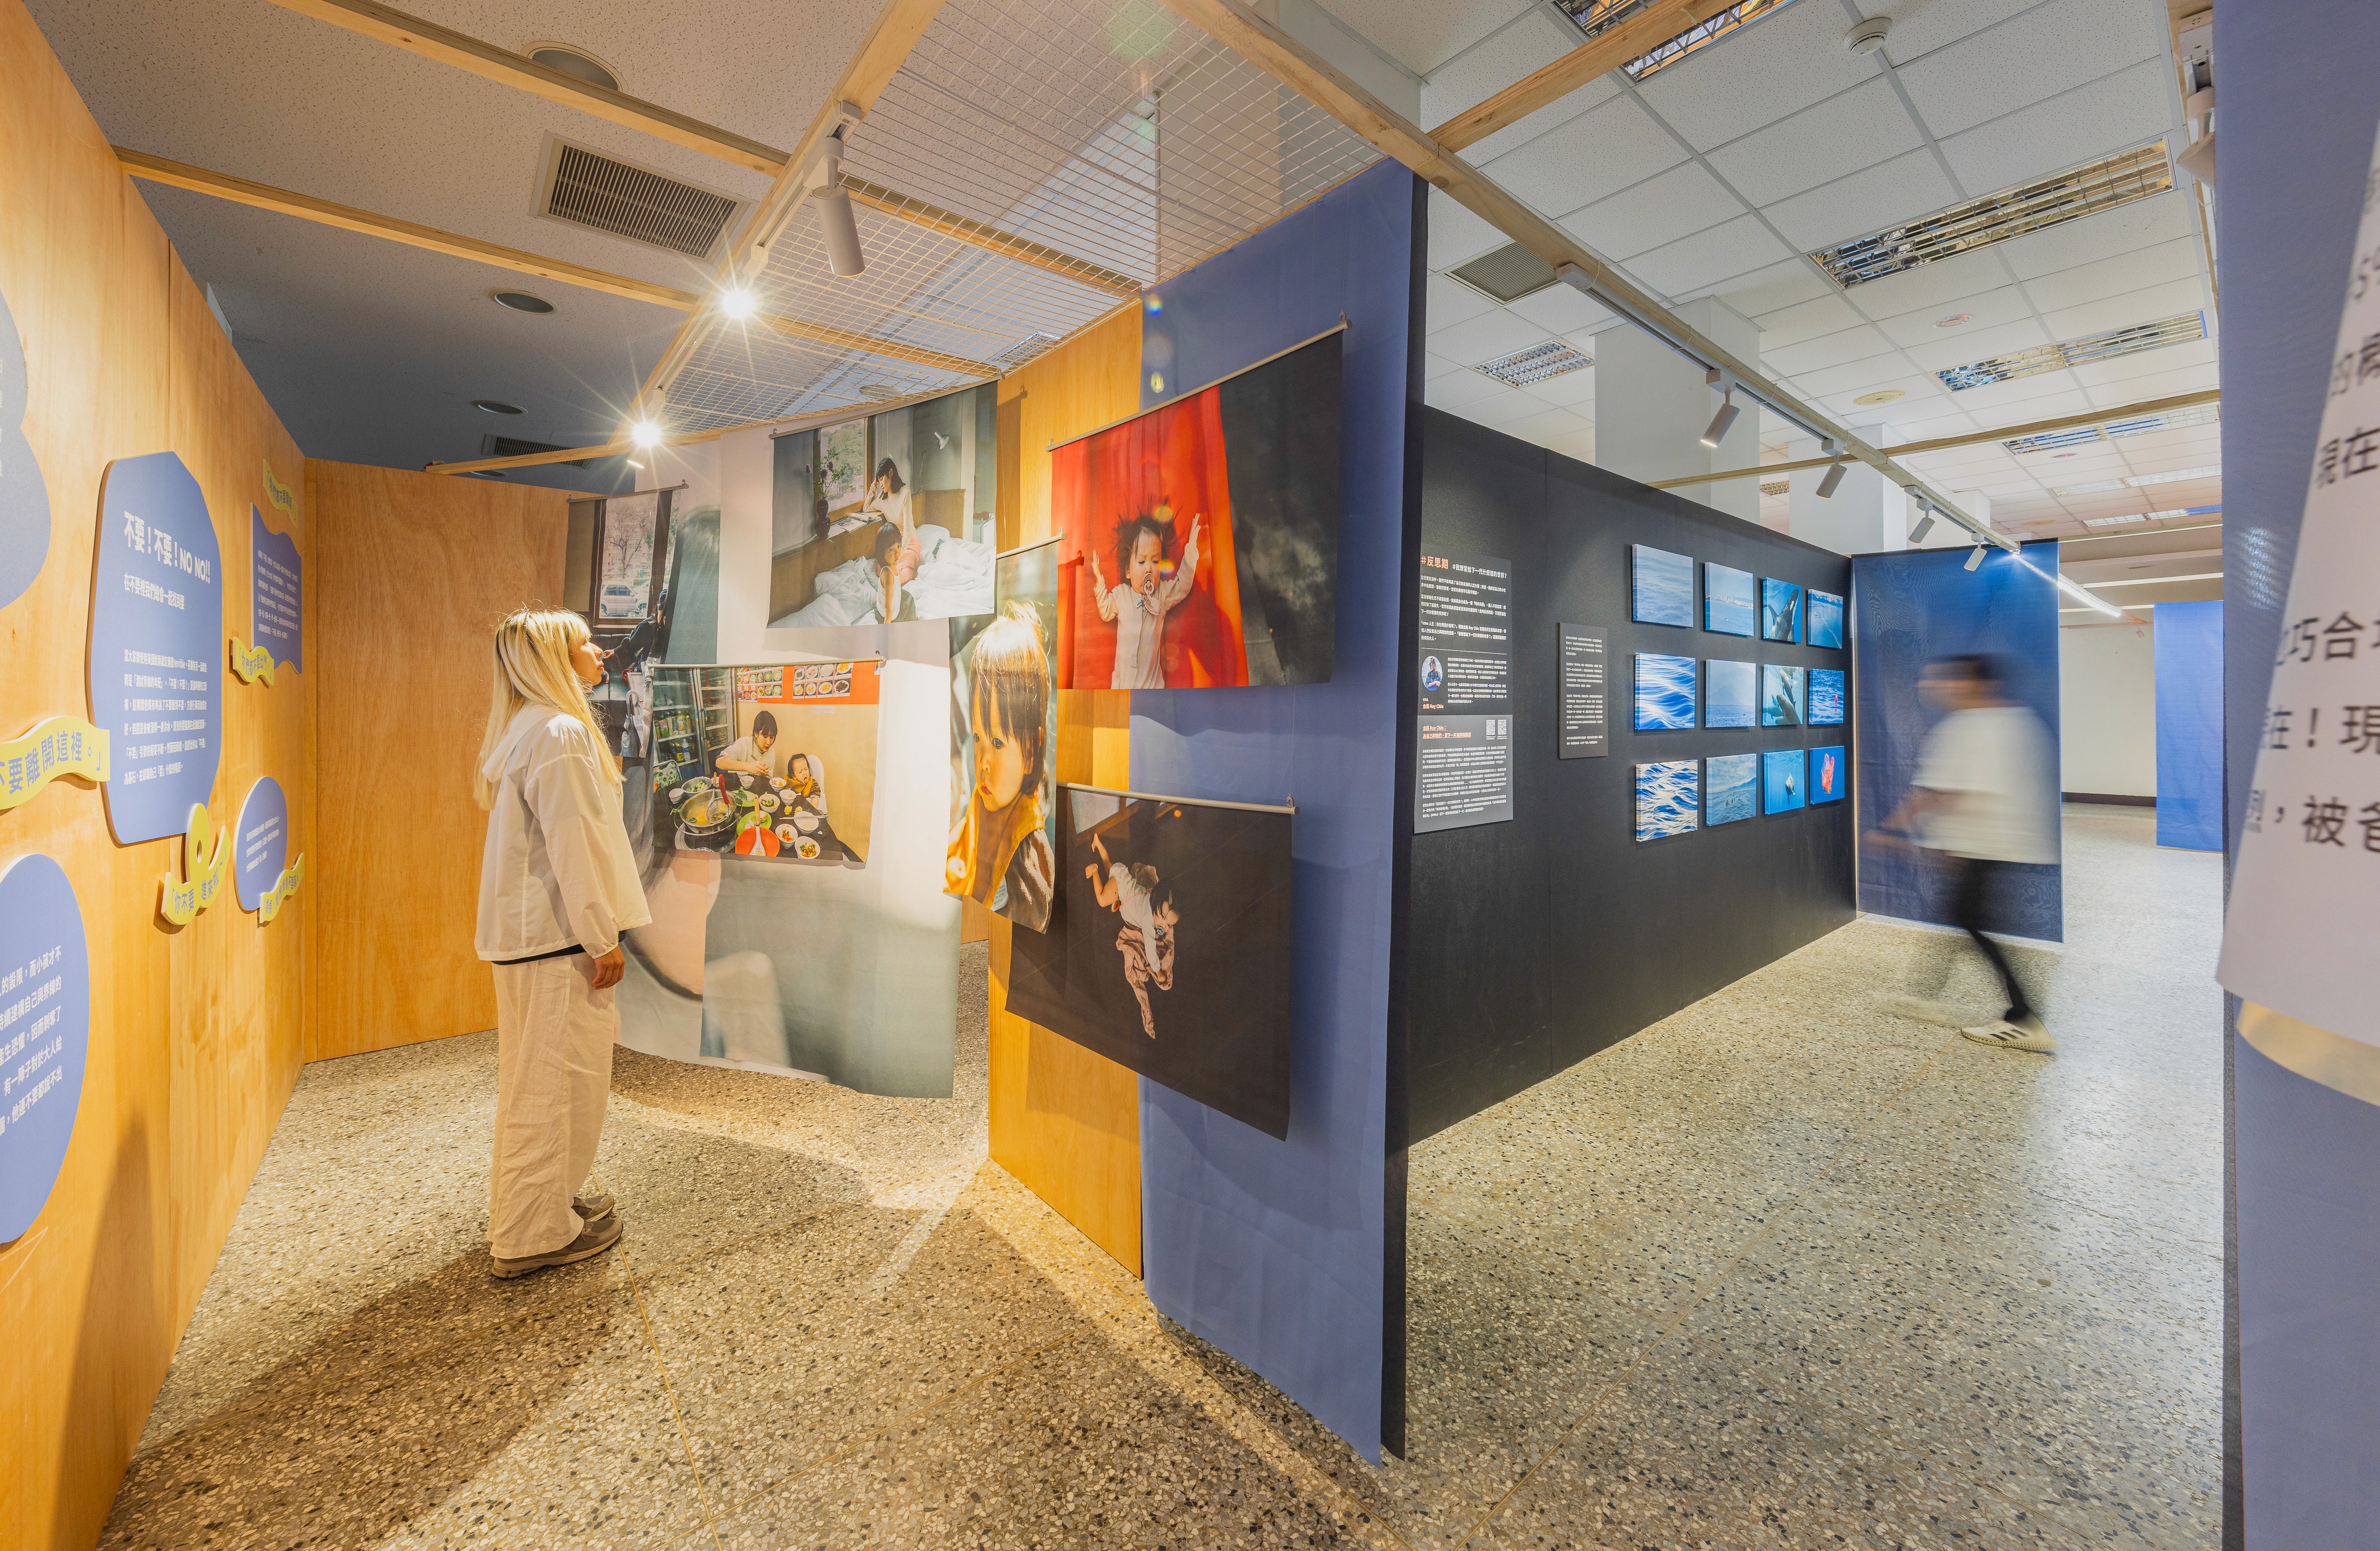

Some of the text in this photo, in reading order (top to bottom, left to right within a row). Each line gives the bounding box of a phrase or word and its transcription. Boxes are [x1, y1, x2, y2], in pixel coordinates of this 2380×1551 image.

[1421, 555, 1449, 570] #反思期
[0, 945, 61, 997] 的設限，而小孩才不
